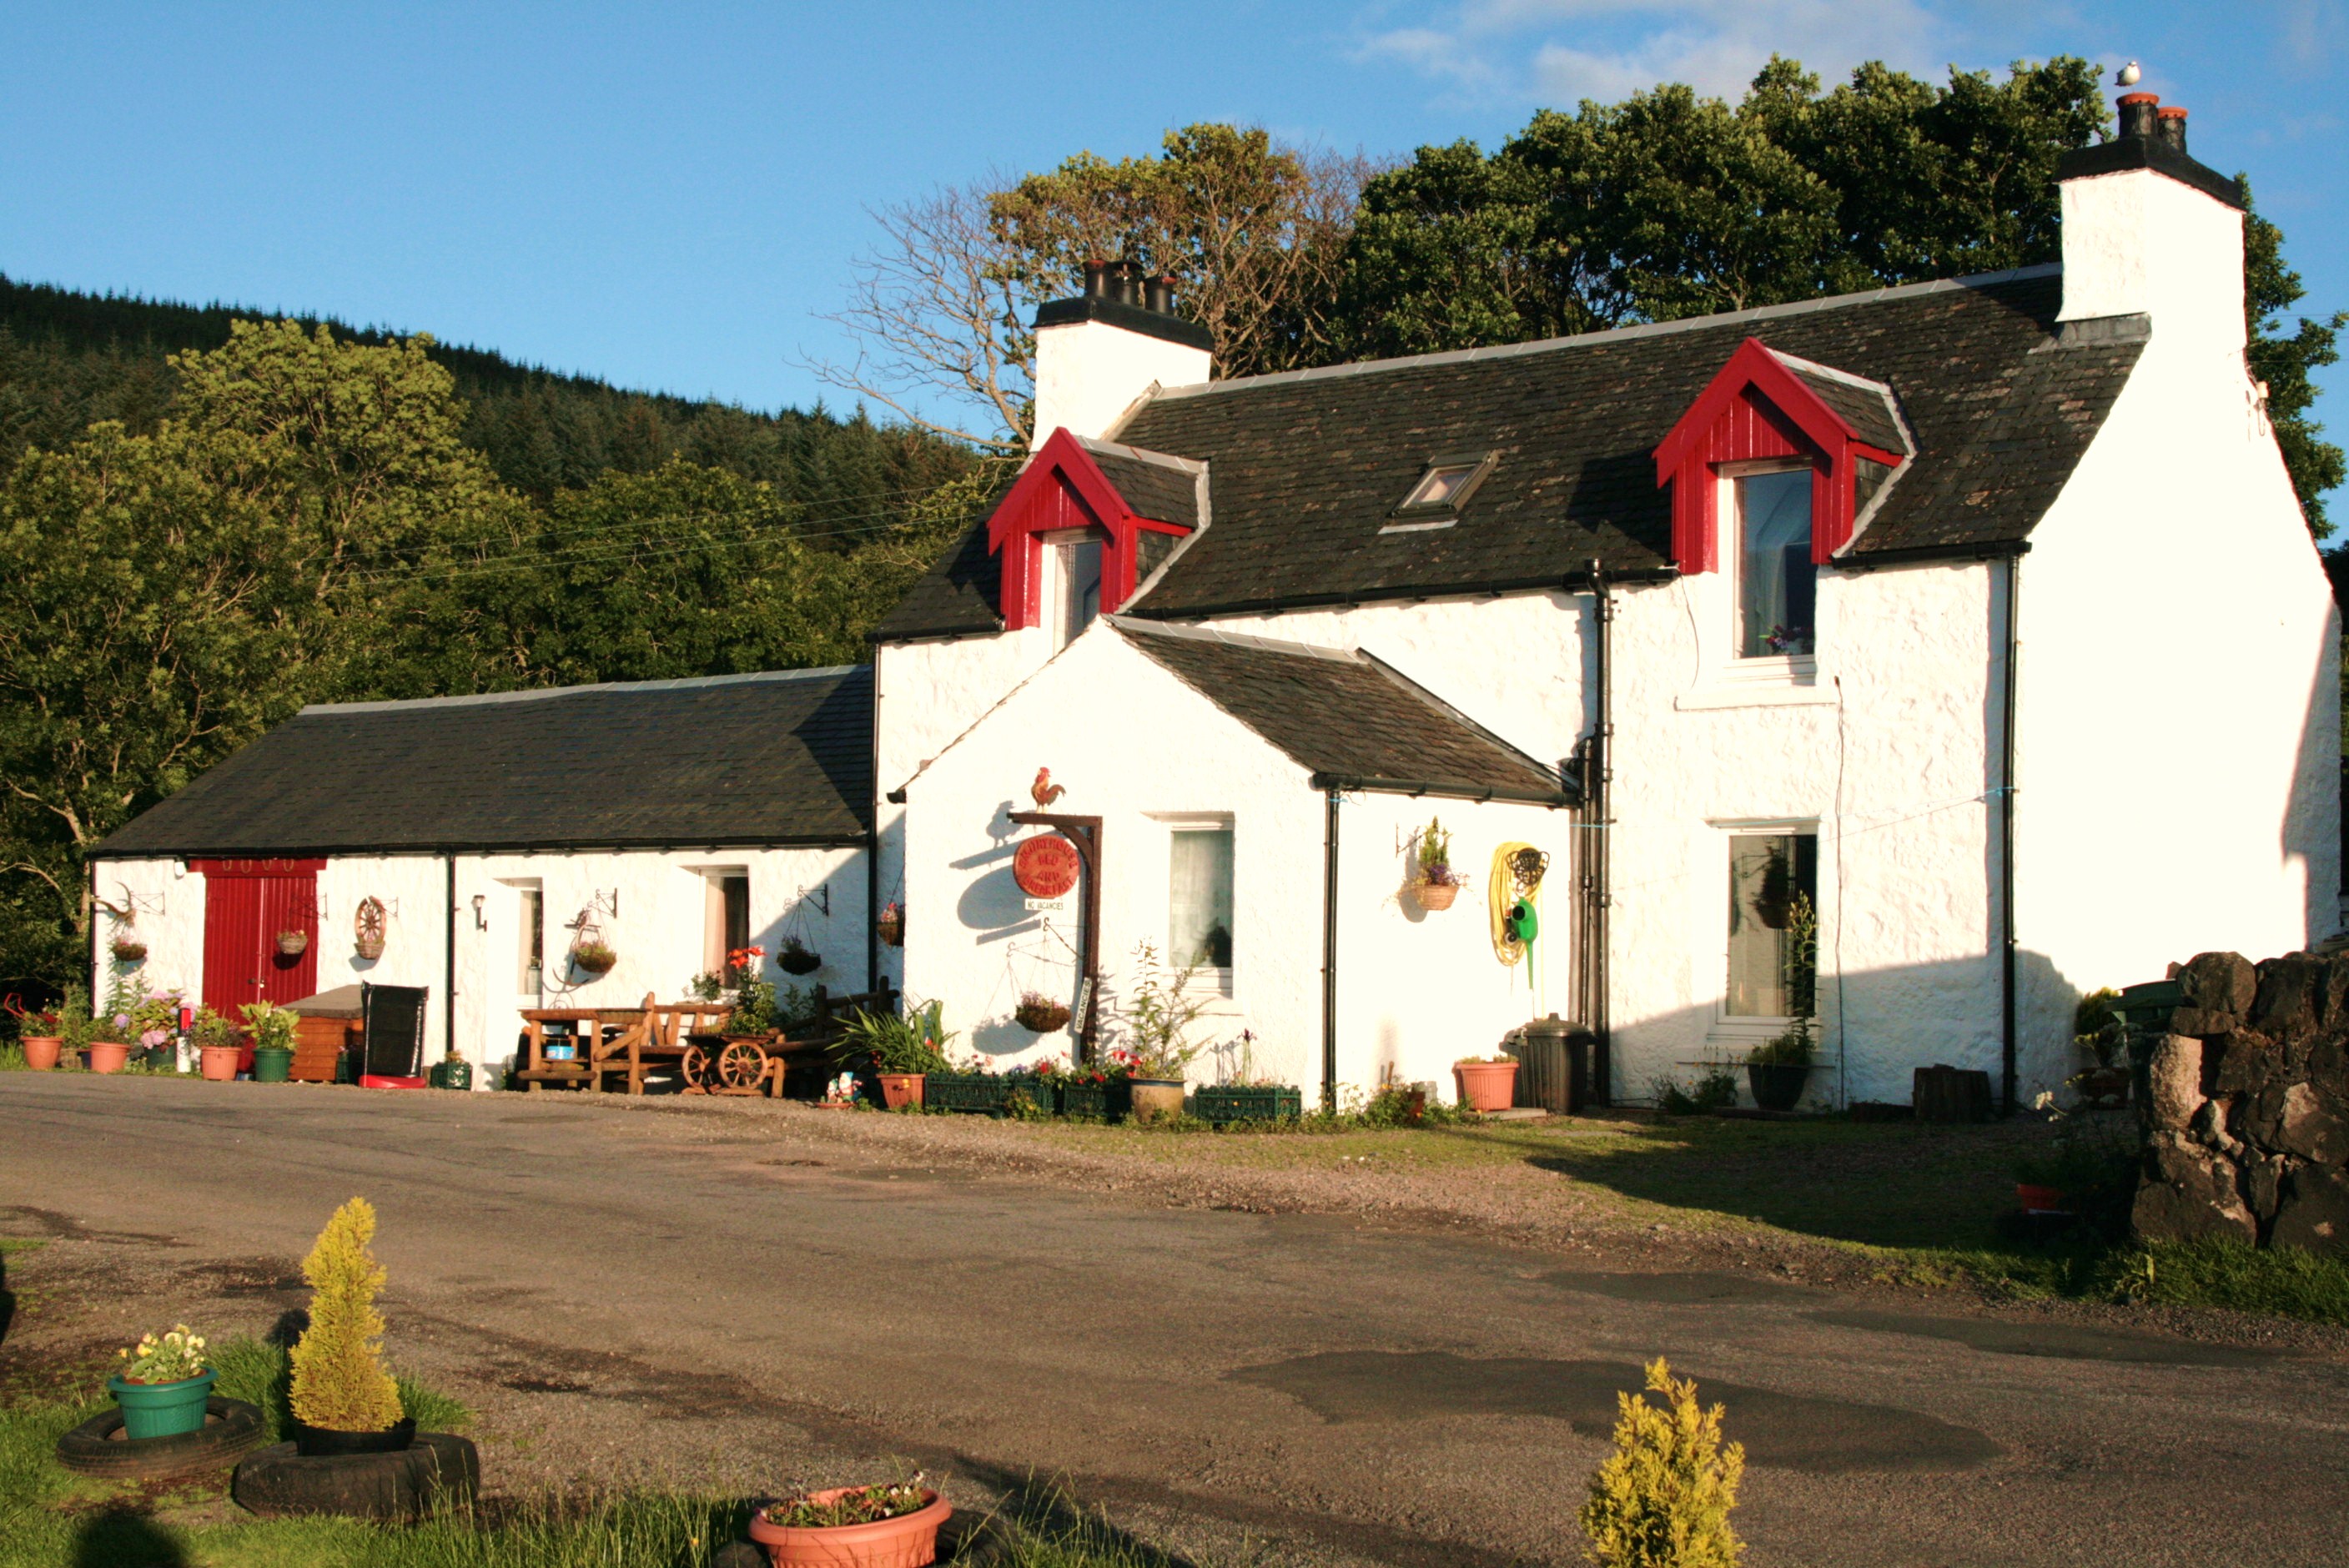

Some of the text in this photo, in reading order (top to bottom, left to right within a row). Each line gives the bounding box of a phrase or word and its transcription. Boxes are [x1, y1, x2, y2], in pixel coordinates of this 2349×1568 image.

[1039, 853, 1059, 866] BED
[1036, 871, 1060, 882] AND
[1022, 874, 1073, 896] BREAKFAST
[1027, 901, 1064, 911] NO VACANCIES
[1075, 980, 1092, 1029] VACANCIES
